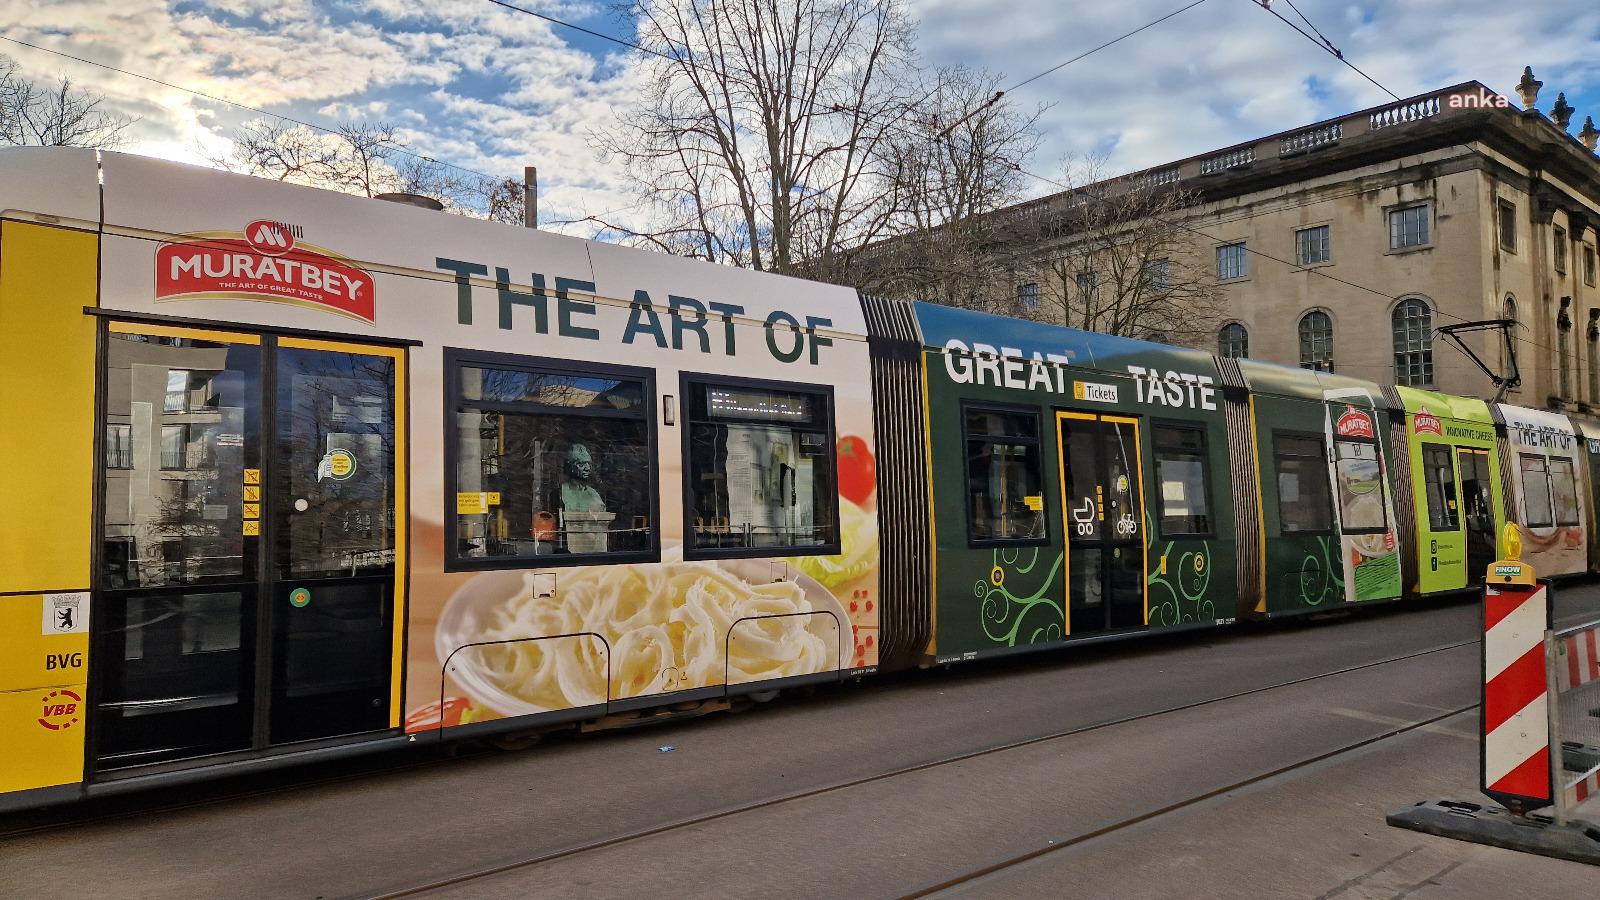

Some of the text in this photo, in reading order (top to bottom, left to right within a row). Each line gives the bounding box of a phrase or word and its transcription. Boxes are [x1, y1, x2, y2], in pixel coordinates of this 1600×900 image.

[170, 254, 363, 300] MURATBEY
[270, 285, 297, 295] GREAT
[298, 289, 324, 300] TASTE
[436, 256, 834, 366] THE ART OF
[943, 339, 1217, 411] GREAT TASTE
[1086, 385, 1116, 401] Tickets
[1340, 418, 1370, 435] MURATBEY
[1514, 421, 1538, 447] THE
[1538, 425, 1557, 449] ART
[46, 653, 82, 670] BVG
[43, 703, 77, 718] VBB
